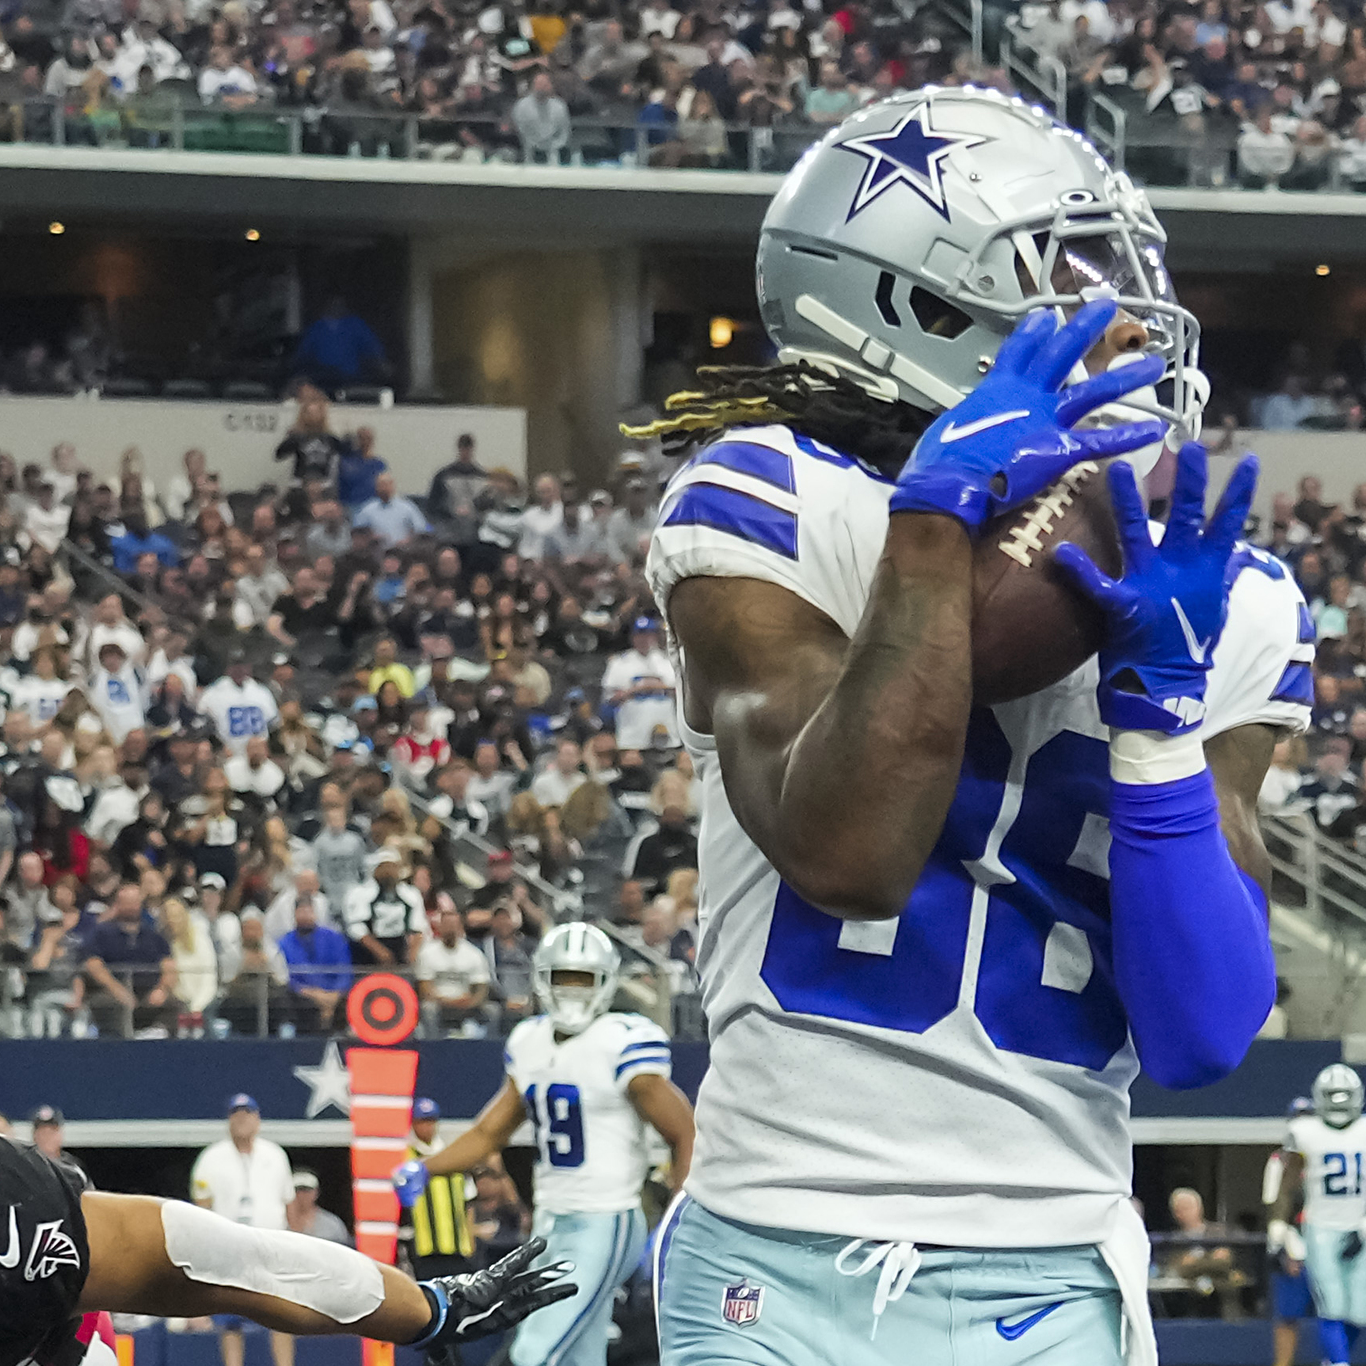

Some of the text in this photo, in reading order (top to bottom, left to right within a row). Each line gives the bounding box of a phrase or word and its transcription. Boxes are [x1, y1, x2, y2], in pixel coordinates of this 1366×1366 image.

[523, 1083, 586, 1168] 19
[1324, 1153, 1362, 1195] 21
[726, 1298, 753, 1321] NFL
